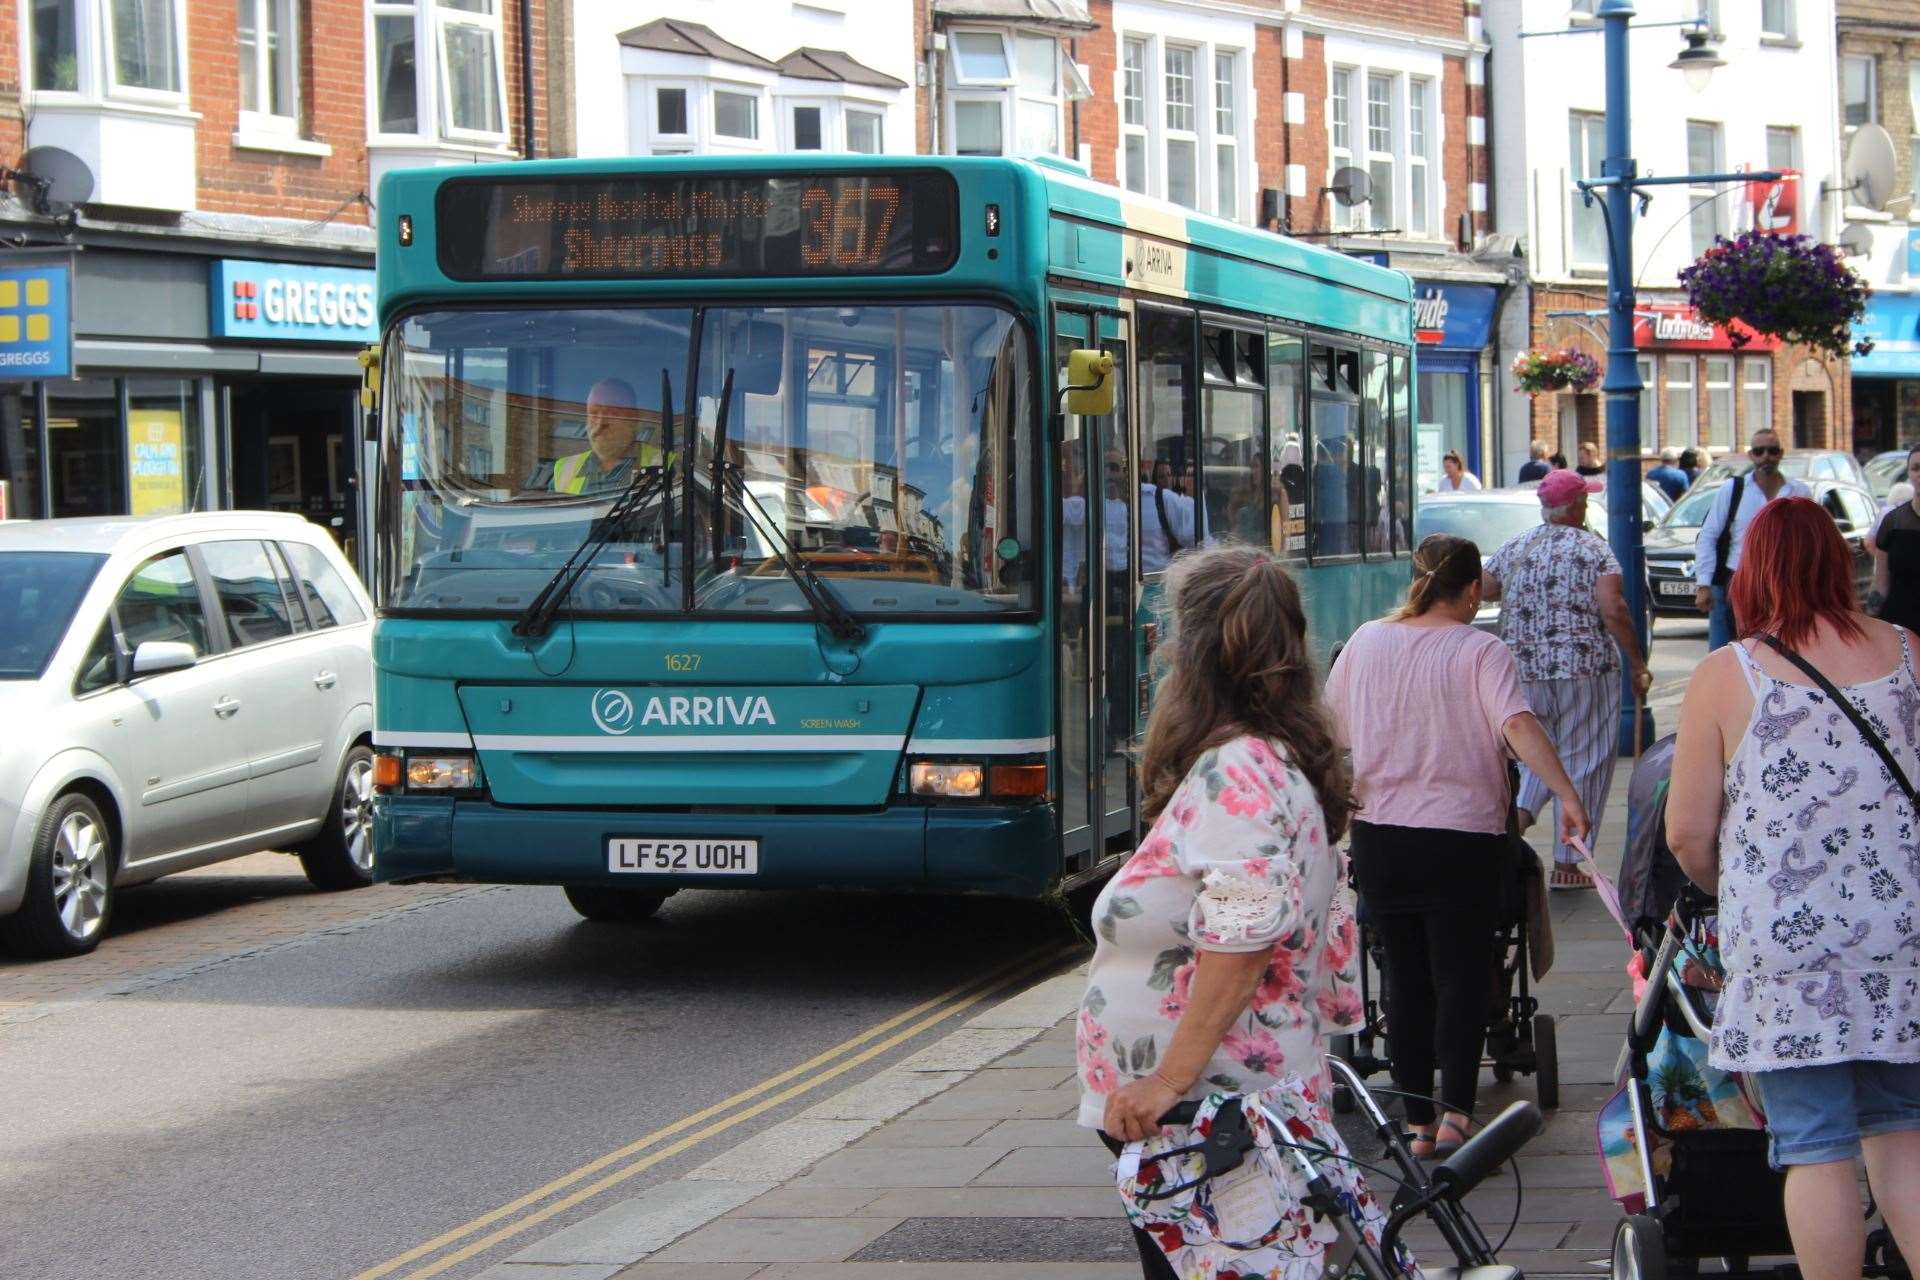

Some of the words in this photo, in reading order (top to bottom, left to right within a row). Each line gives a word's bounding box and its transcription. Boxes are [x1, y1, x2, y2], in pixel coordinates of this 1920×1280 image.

[802, 187, 900, 265] 367
[563, 228, 722, 269] Sheerness
[1146, 246, 1173, 275] ARRIVA
[264, 278, 375, 328] GREGGS
[663, 654, 702, 671] 1627
[641, 696, 776, 726] ARRIVA
[800, 719, 832, 729] SCREEN
[833, 719, 860, 729] WASH
[619, 843, 687, 869] LF52
[695, 844, 746, 869] UOH
